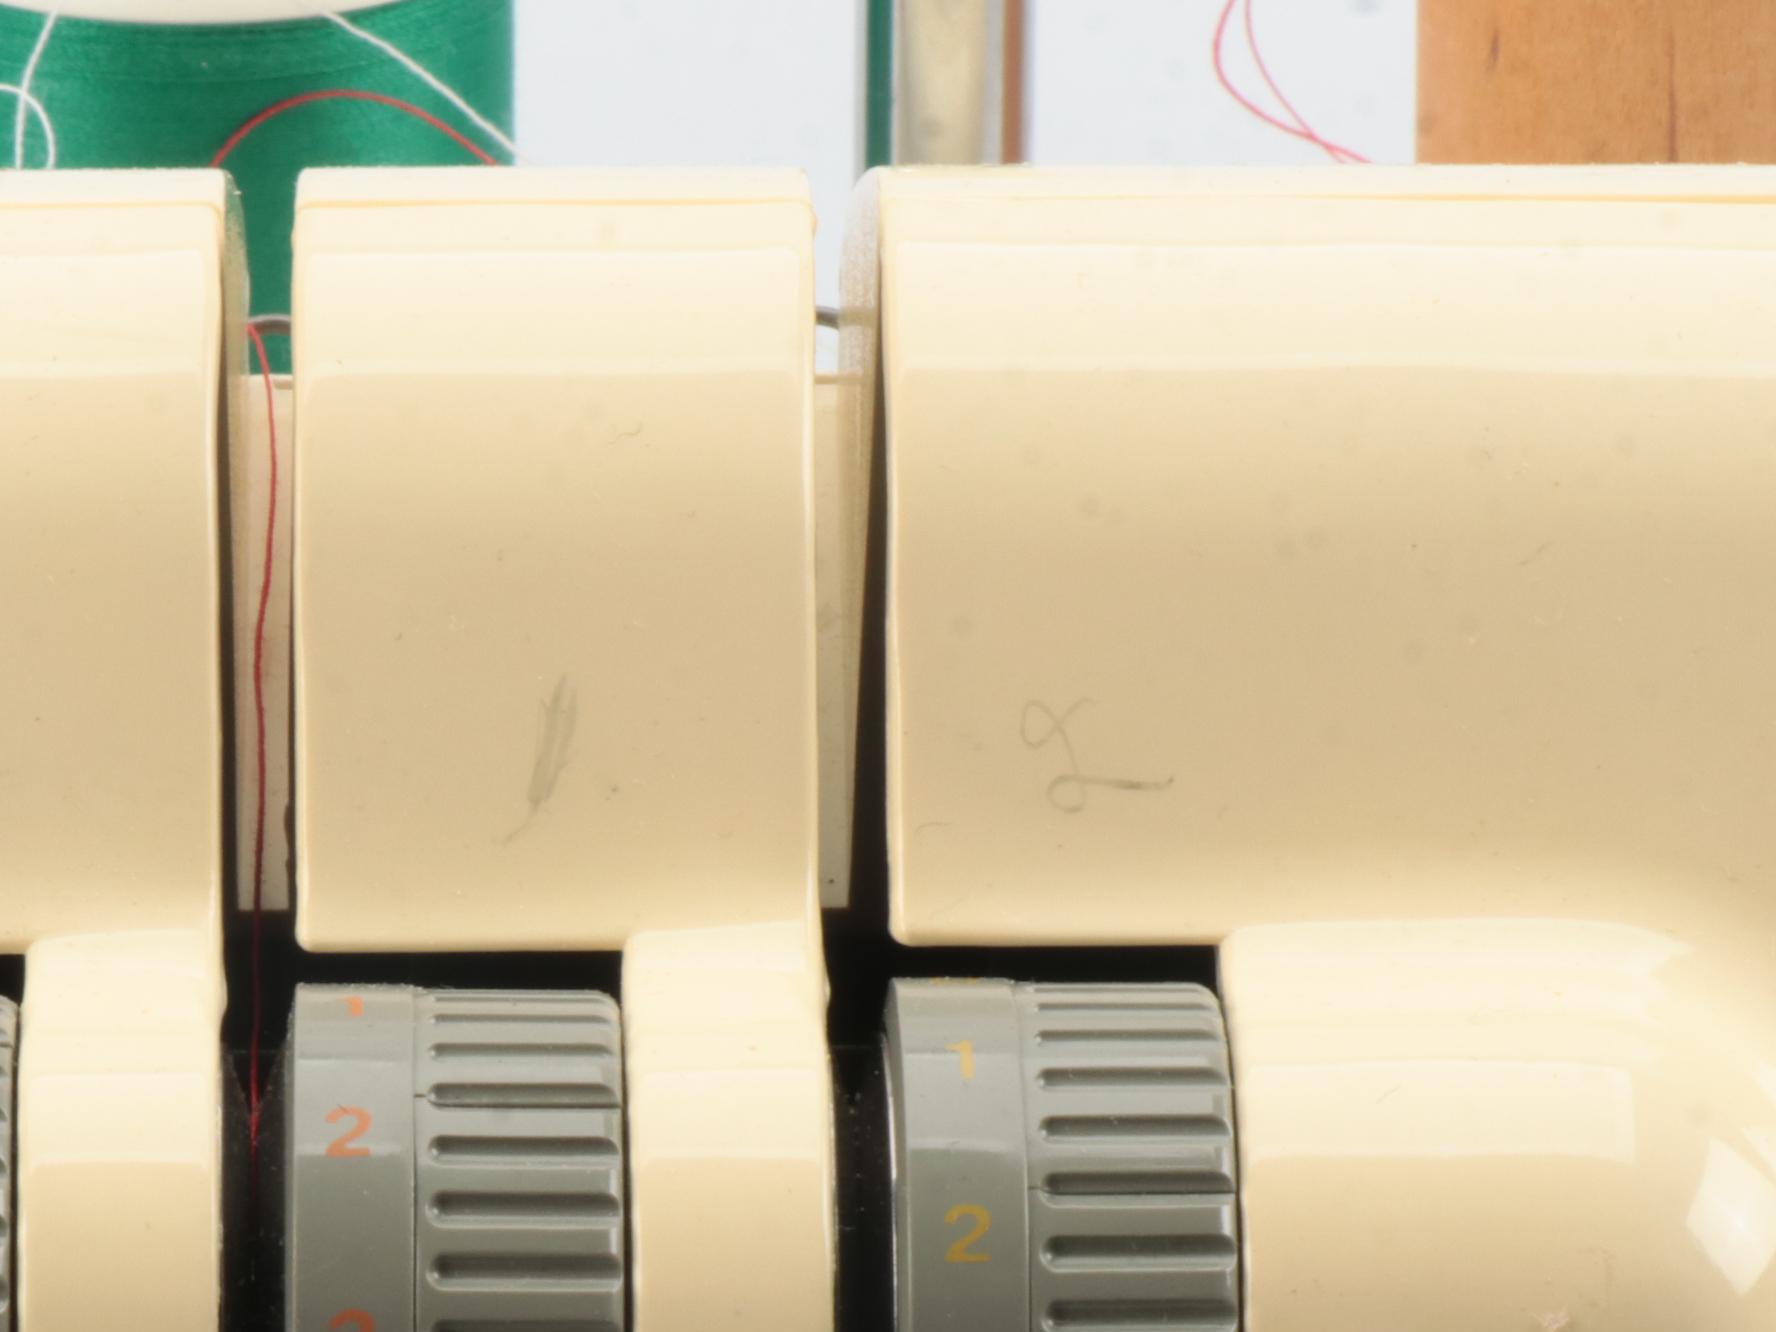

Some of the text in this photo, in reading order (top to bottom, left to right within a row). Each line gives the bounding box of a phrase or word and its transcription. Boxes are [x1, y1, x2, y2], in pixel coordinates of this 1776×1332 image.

[944, 1039, 976, 1081] 1
[324, 1105, 374, 1159] 2
[944, 1203, 993, 1265] 2
